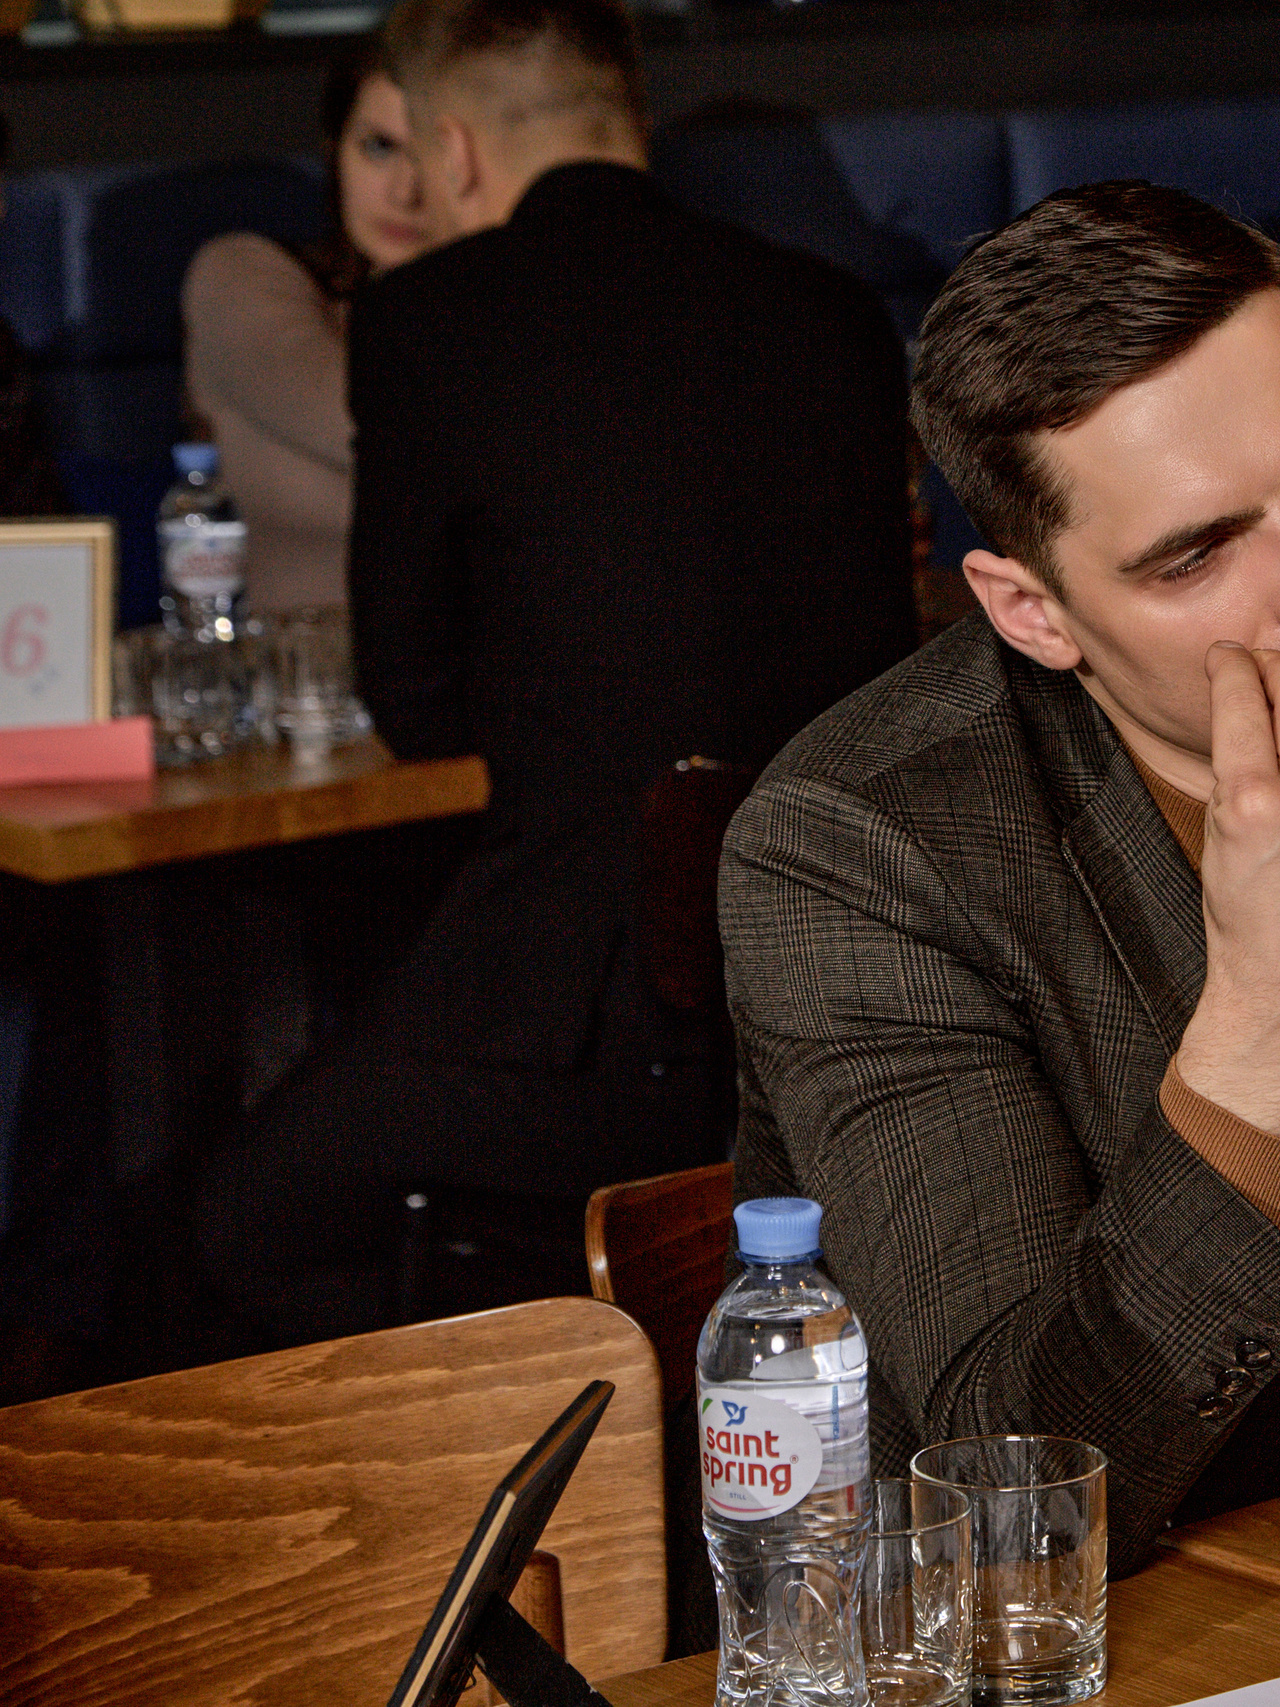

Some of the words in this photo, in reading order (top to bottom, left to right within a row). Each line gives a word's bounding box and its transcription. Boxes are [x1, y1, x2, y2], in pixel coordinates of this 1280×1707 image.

[0, 602, 49, 678] 6
[706, 1426, 780, 1458] saint
[703, 1452, 792, 1496] spring
[729, 1492, 747, 1500] STILL
